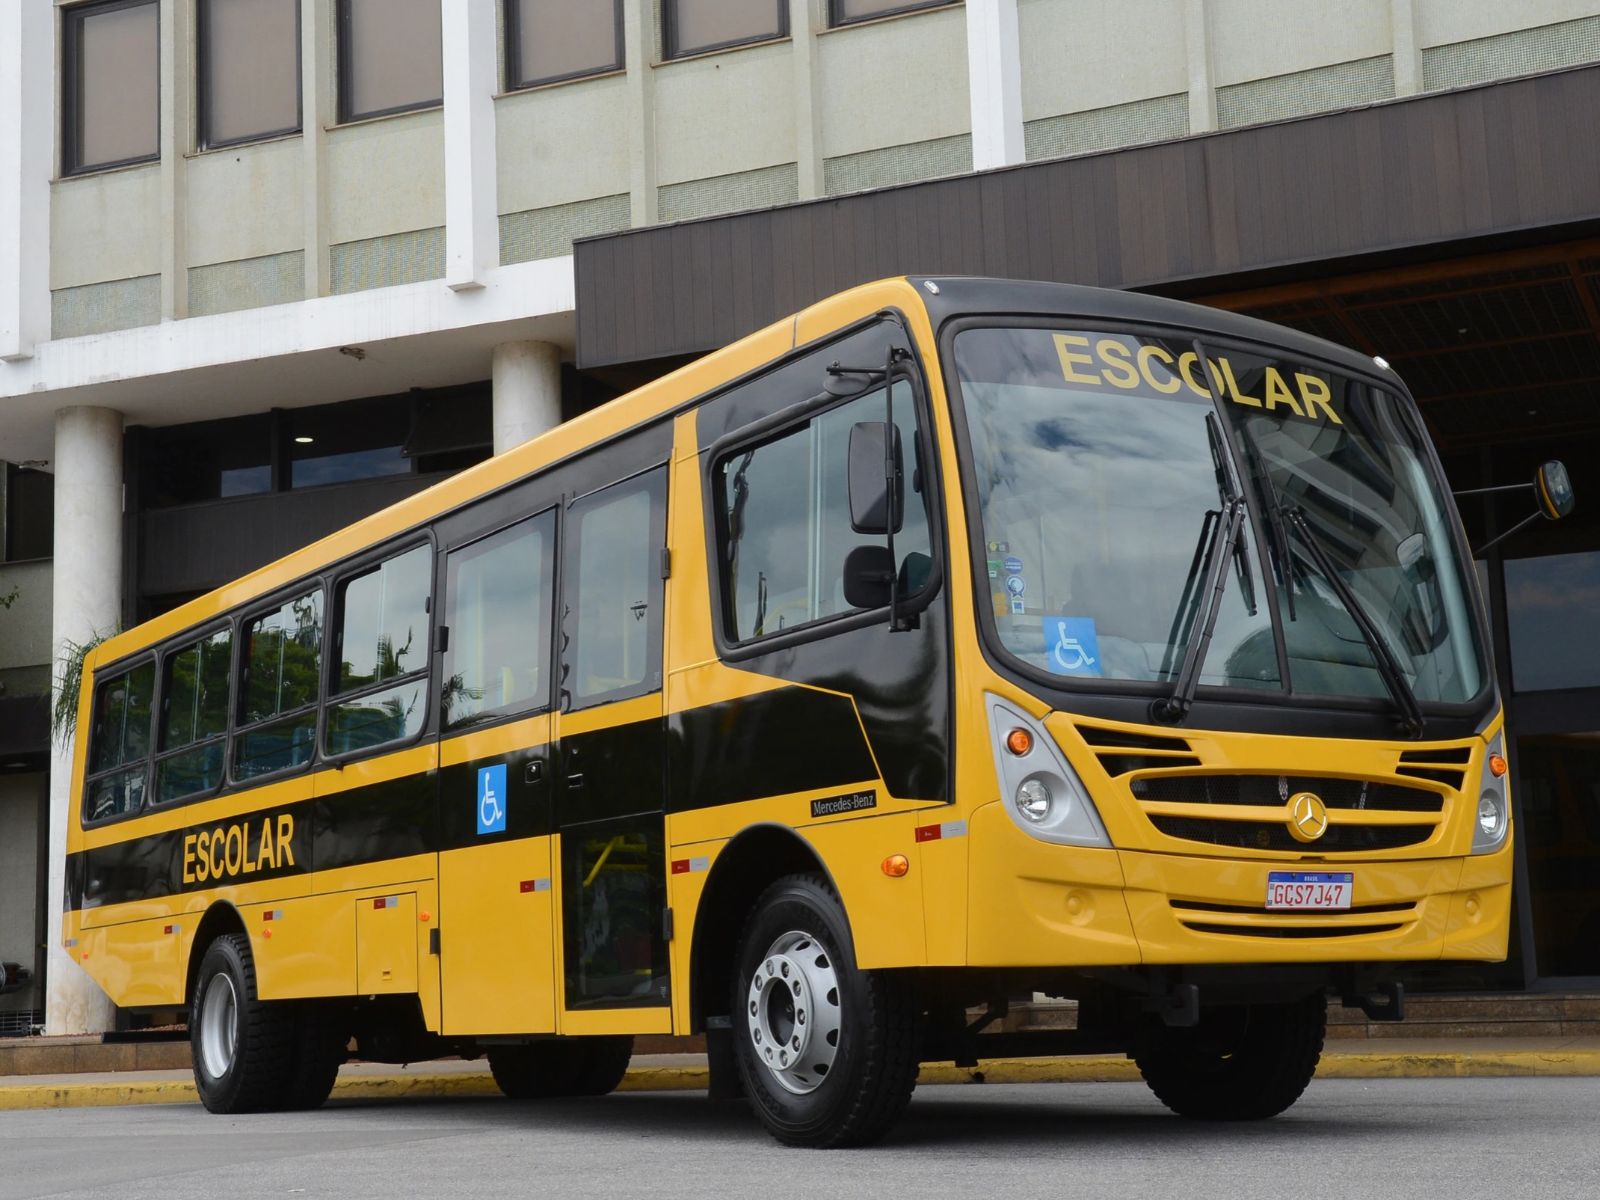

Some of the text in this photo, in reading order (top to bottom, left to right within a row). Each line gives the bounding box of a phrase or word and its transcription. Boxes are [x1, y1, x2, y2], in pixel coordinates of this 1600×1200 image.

[1052, 333, 1343, 425] ESCOLAR
[813, 794, 874, 816] Mercedes-Benz
[183, 813, 295, 884] ESCOLAR
[1274, 884, 1343, 905] GCS7J47
